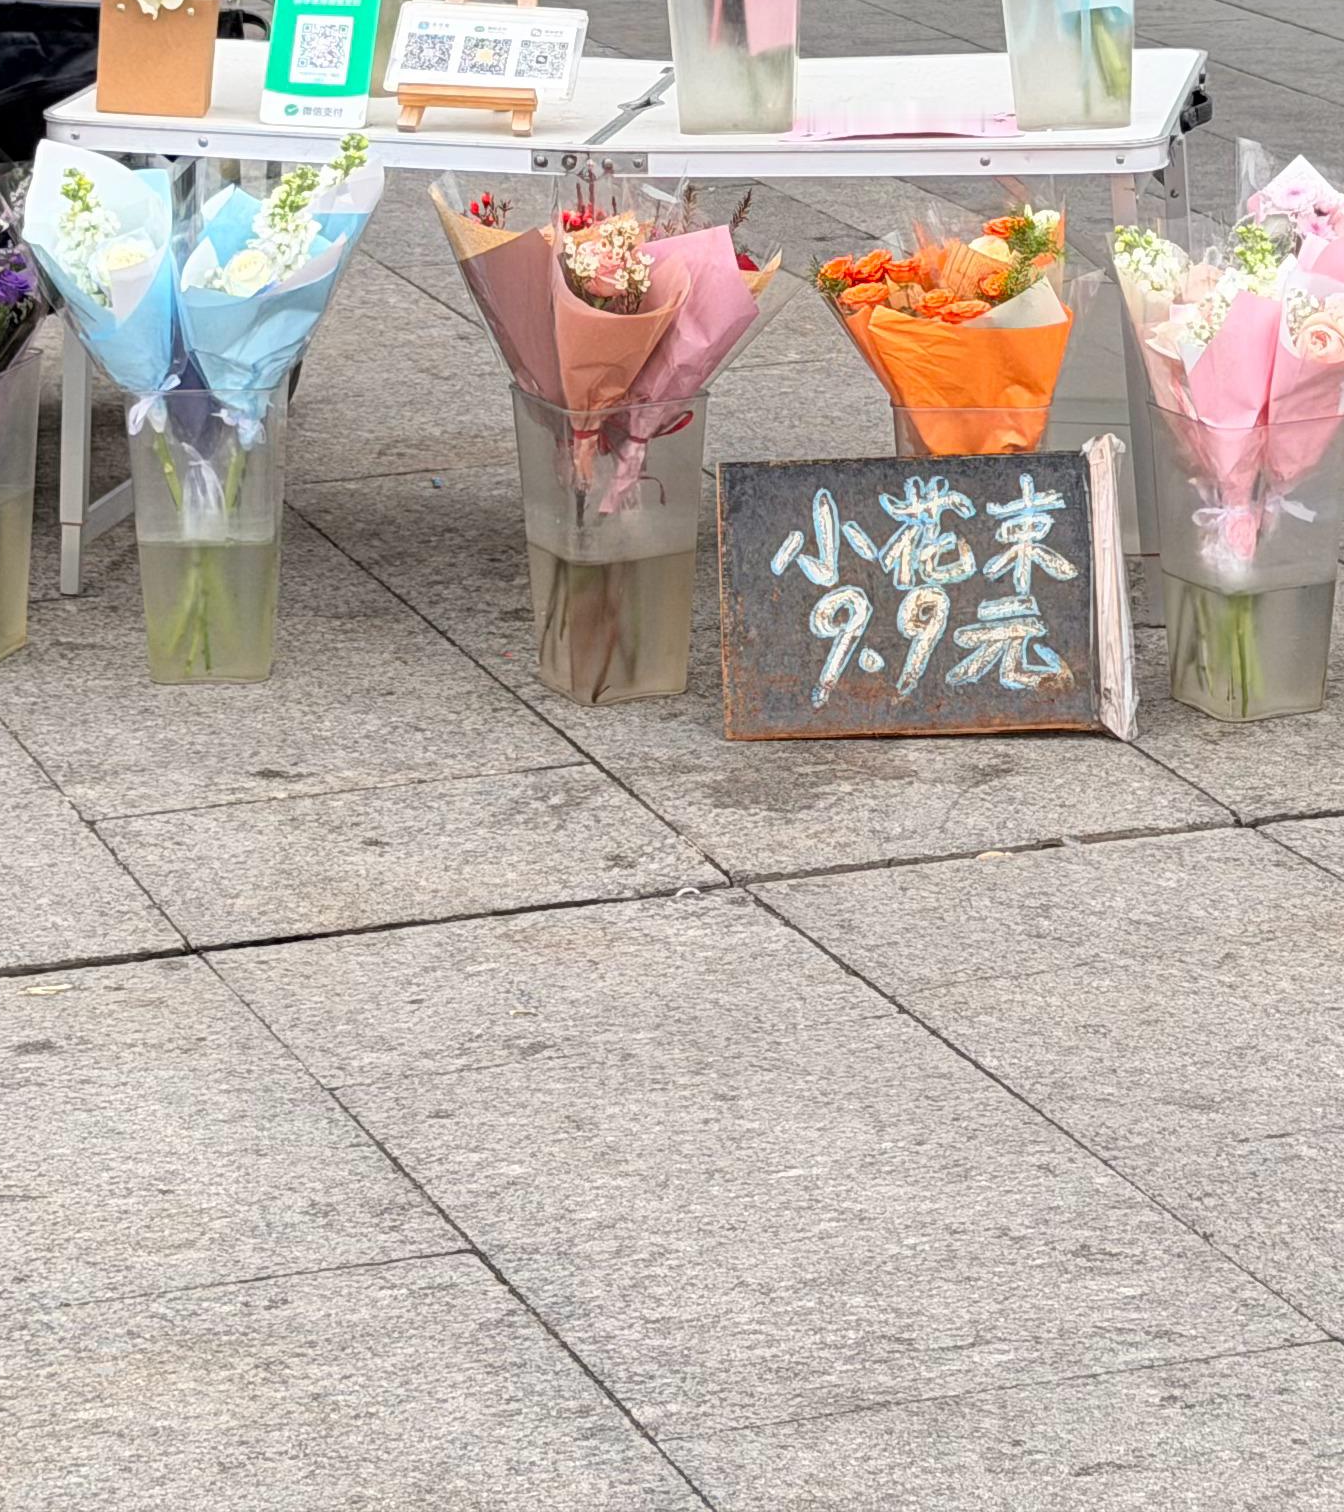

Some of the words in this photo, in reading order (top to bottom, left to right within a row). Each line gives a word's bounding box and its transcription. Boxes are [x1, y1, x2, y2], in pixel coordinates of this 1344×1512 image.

[302, 106, 343, 118] 微信支付
[770, 472, 1079, 594] 小花束
[808, 584, 1074, 709] 9.9元
